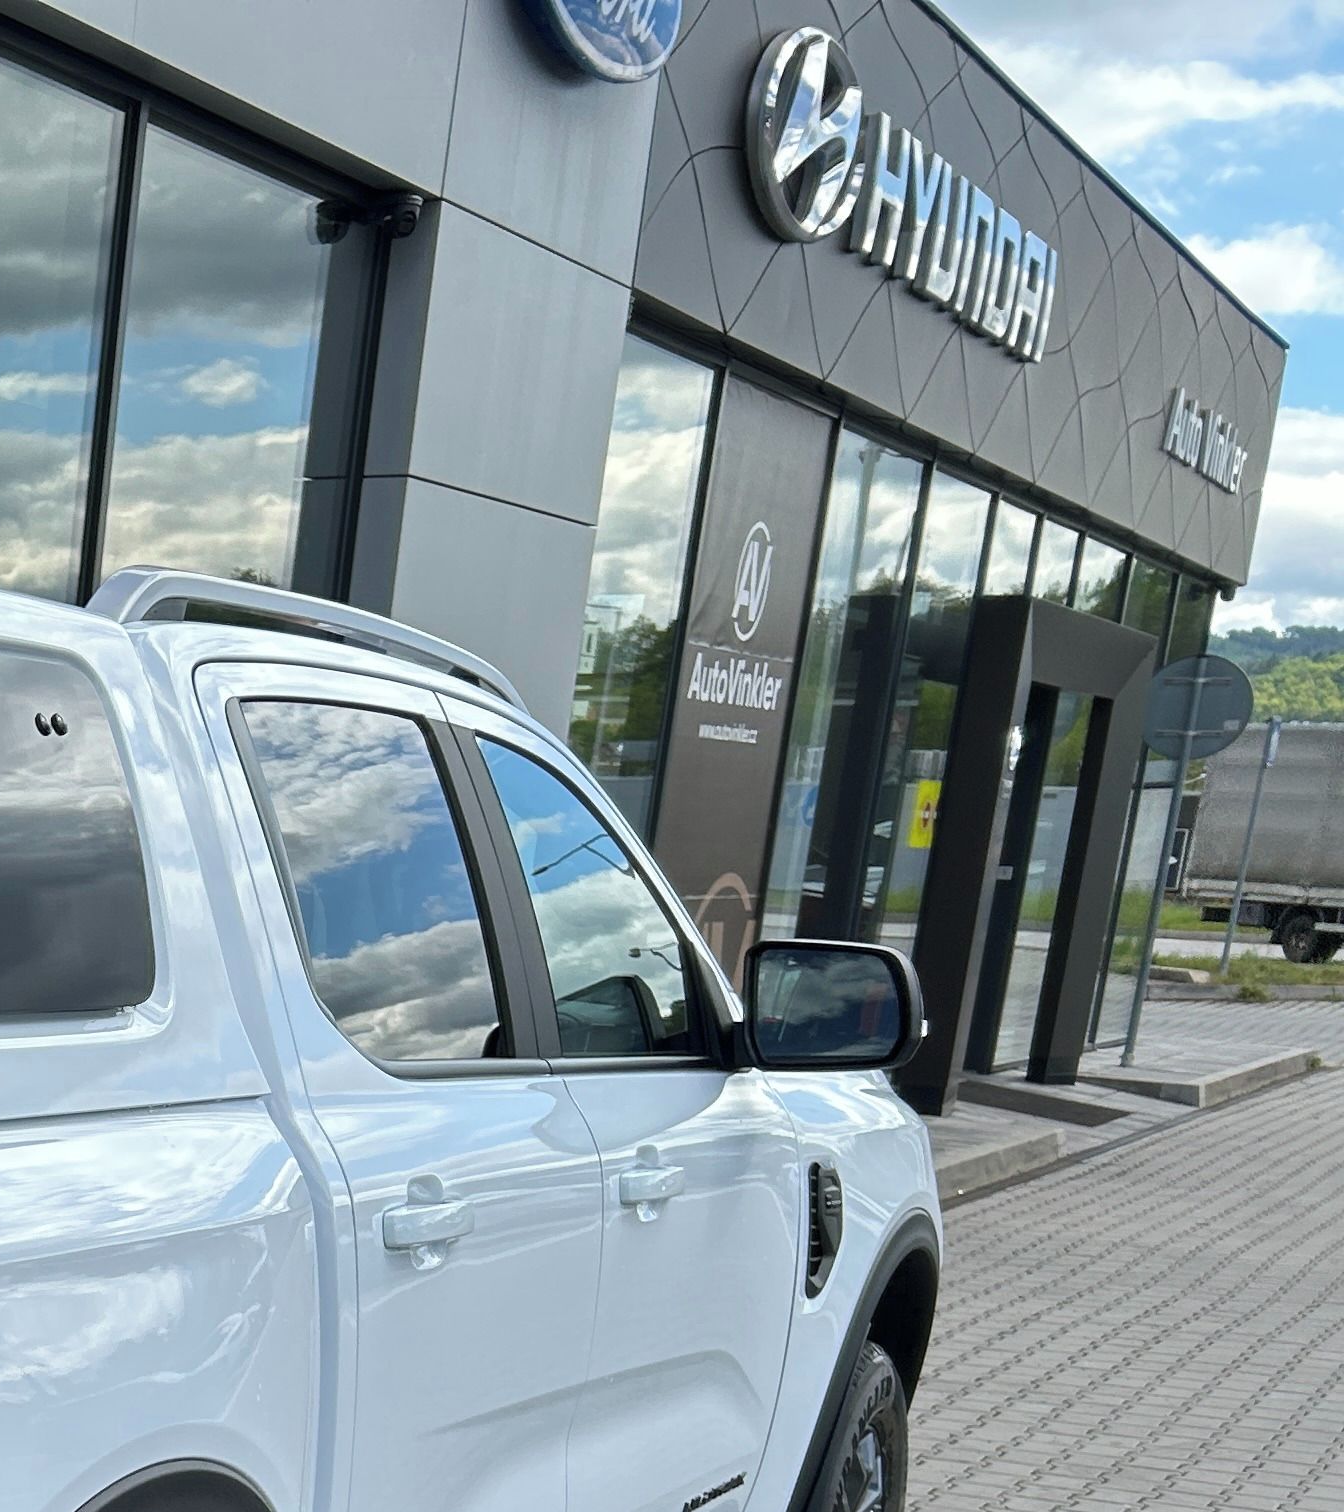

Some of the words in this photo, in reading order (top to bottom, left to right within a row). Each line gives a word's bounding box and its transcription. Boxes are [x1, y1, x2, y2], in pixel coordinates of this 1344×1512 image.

[852, 111, 1058, 364] HYUNDAI
[1164, 386, 1204, 469] Auto
[1201, 408, 1248, 495] Vinkler
[687, 652, 782, 711] AutoVinkler
